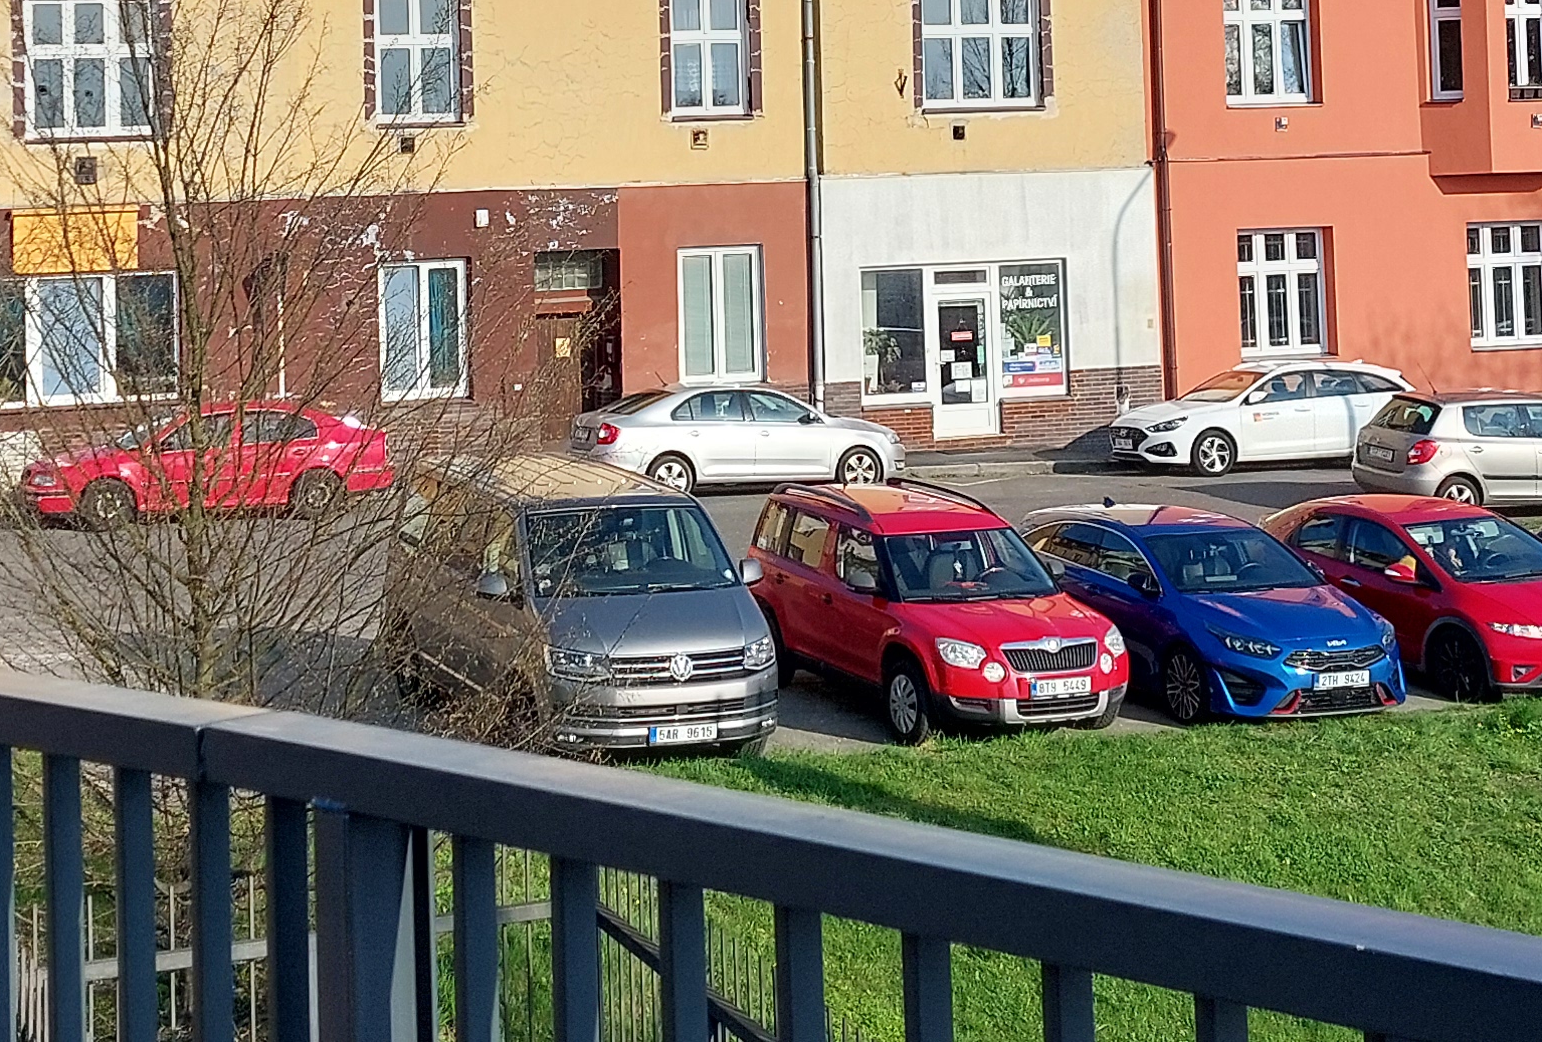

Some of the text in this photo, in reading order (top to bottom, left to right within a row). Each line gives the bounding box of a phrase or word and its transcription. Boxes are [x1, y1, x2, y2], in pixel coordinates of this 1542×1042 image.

[1001, 274, 1057, 286] GALANTERIE
[1024, 286, 1033, 297] &
[1063, 679, 1087, 692] 5449
[1321, 675, 1339, 687] 2TH
[659, 726, 713, 741] 5AR 9615
